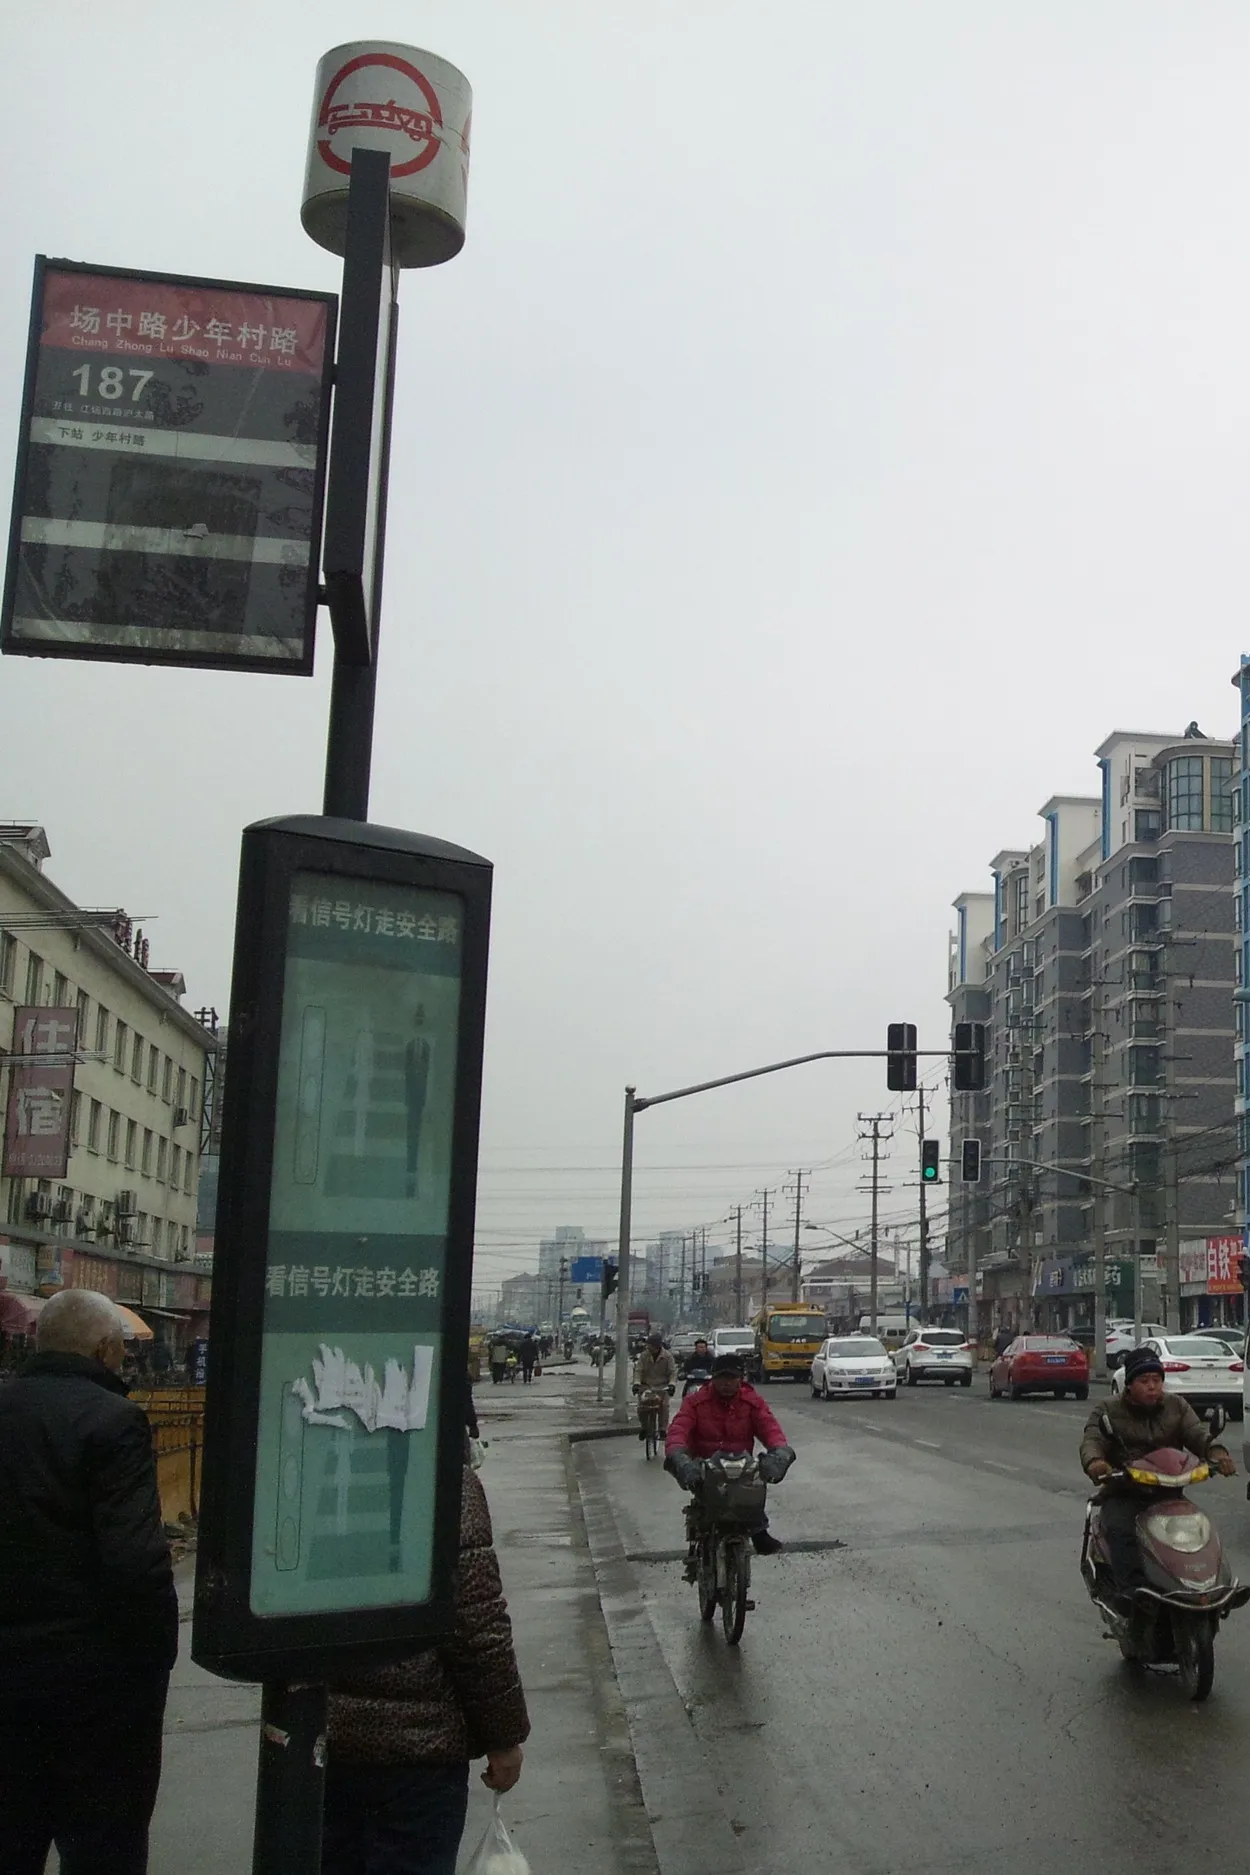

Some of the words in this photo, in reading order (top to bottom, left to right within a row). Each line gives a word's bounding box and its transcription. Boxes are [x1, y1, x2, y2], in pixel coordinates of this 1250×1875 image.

[69, 304, 299, 356] 场中路少年村路
[71, 335, 109, 349] Chang
[116, 340, 154, 354] Zhong
[159, 343, 174, 354] Lu
[181, 344, 210, 358] Shao
[216, 349, 243, 361] Nian
[250, 352, 271, 364] Cun
[277, 356, 292, 367] Lu
[72, 363, 154, 402] 187
[91, 430, 149, 447] 少年村路
[288, 893, 460, 945] 看信号灯走安全路
[265, 1264, 441, 1299] 看信号灯走安全路
